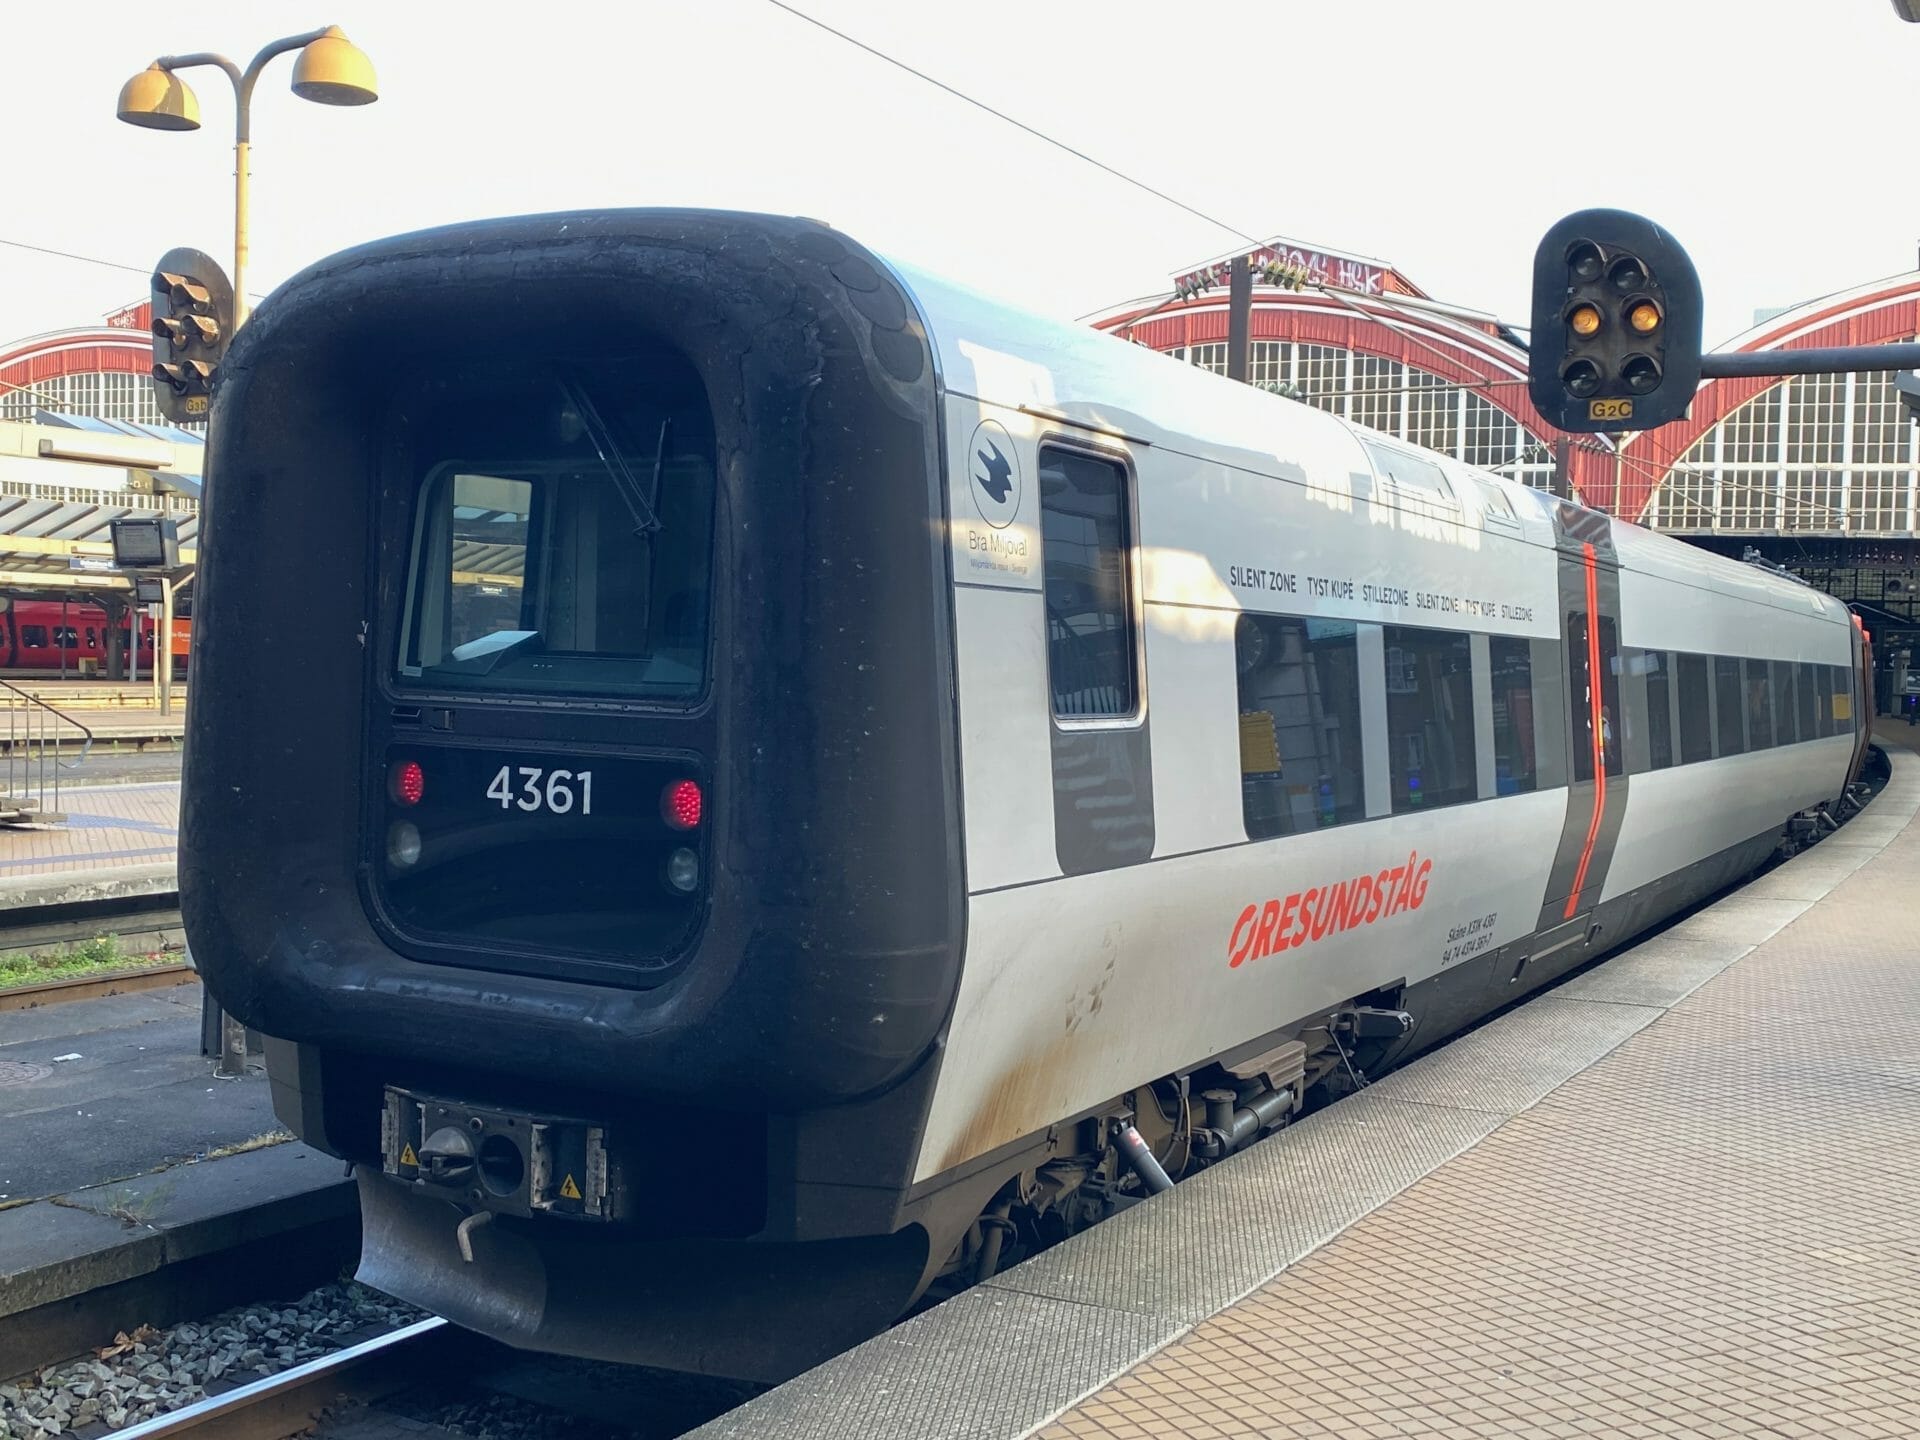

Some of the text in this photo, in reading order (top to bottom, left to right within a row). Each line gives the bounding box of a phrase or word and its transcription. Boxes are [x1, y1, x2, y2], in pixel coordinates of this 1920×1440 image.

[1592, 401, 1632, 418] G2C
[969, 530, 988, 551] Bra
[1230, 565, 1267, 590] SILENT
[1269, 571, 1297, 594] ZONE
[1307, 577, 1329, 597] TYST
[1331, 578, 1354, 600] KUPÉ
[1362, 584, 1409, 607] STILLEZONE
[1416, 591, 1440, 611] SILENT
[1440, 595, 1459, 613] ZONE
[1501, 603, 1533, 622] STILLEZONE
[486, 765, 592, 815] 4361
[1228, 849, 1433, 969] ØRESUNDSTÅG
[1447, 923, 1467, 943] Skåne
[1482, 911, 1498, 929] 4361
[1441, 949, 1452, 966] 94
[1451, 945, 1461, 962] 74
